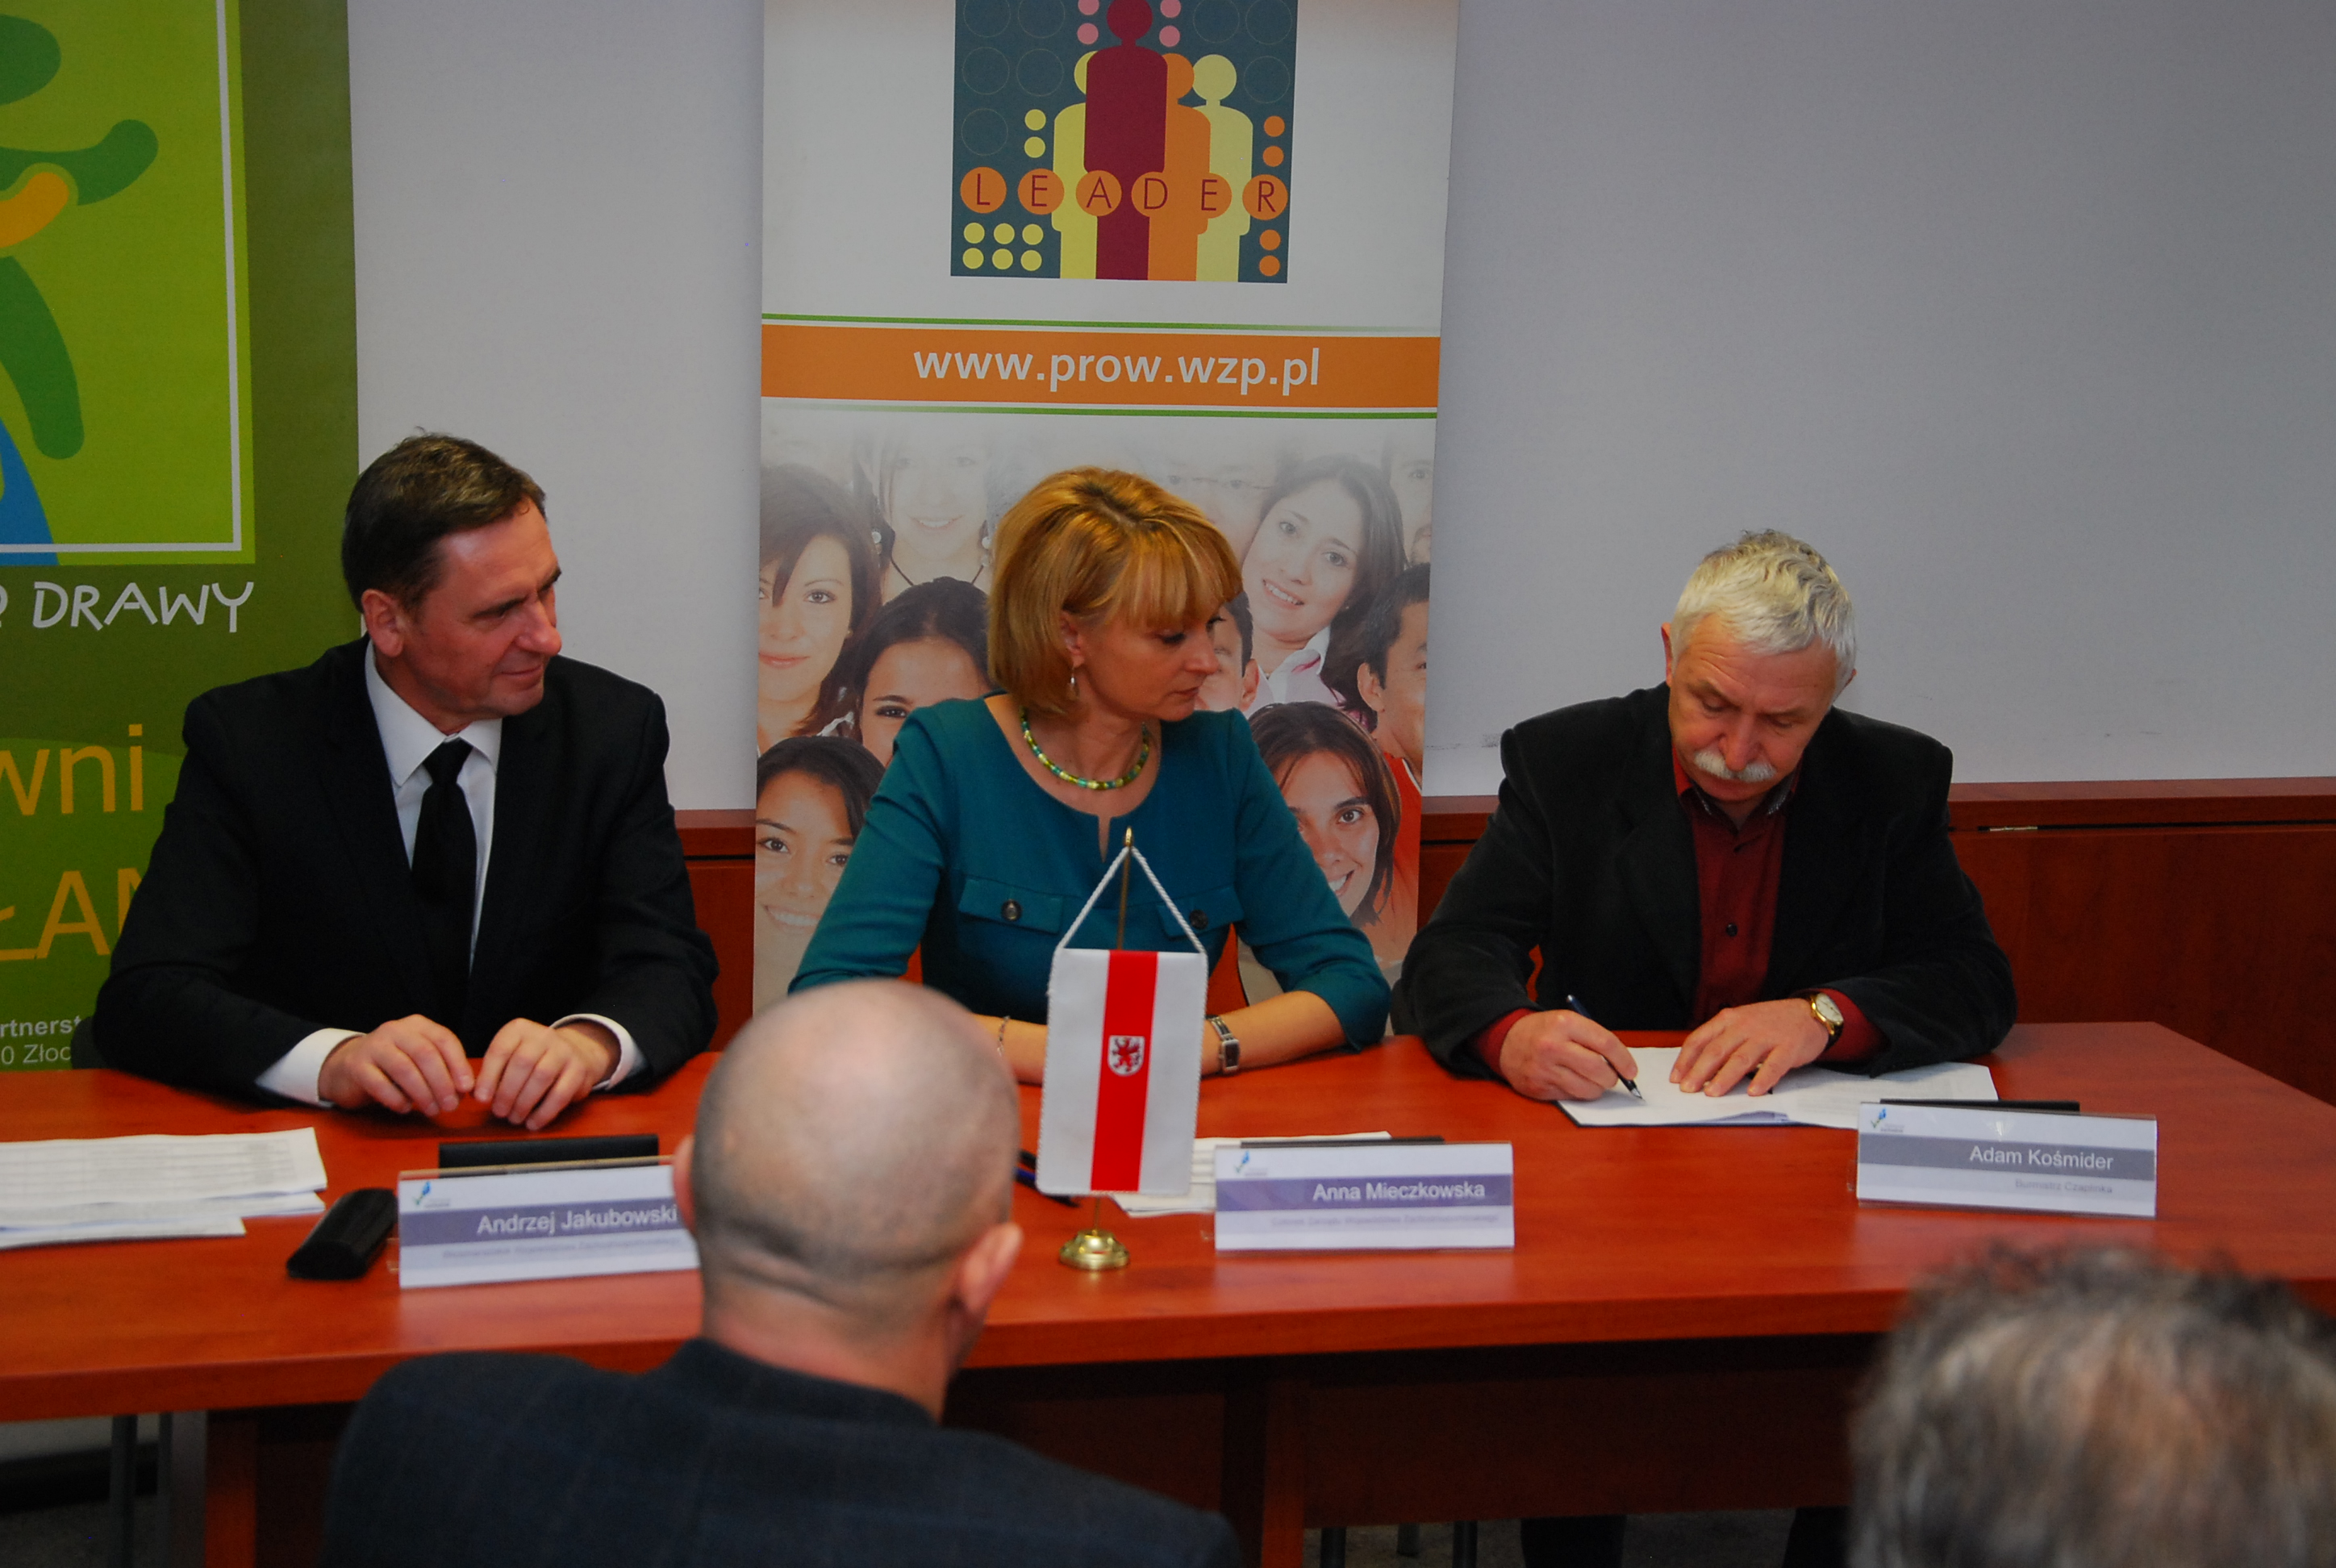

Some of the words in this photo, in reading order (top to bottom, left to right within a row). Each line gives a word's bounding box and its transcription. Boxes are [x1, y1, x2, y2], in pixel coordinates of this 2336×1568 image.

[975, 173, 1276, 213] LEADER
[913, 347, 1320, 395] www.prow.wzp.pl
[32, 580, 254, 633] DRAWY
[1969, 1145, 2022, 1165] Adam
[2028, 1149, 2114, 1170] Kośmider
[1312, 1182, 1362, 1202] Anna
[1366, 1180, 1485, 1201] Mieczkowska
[477, 1211, 556, 1236] Andrzej
[561, 1203, 678, 1231] Jakubowski
